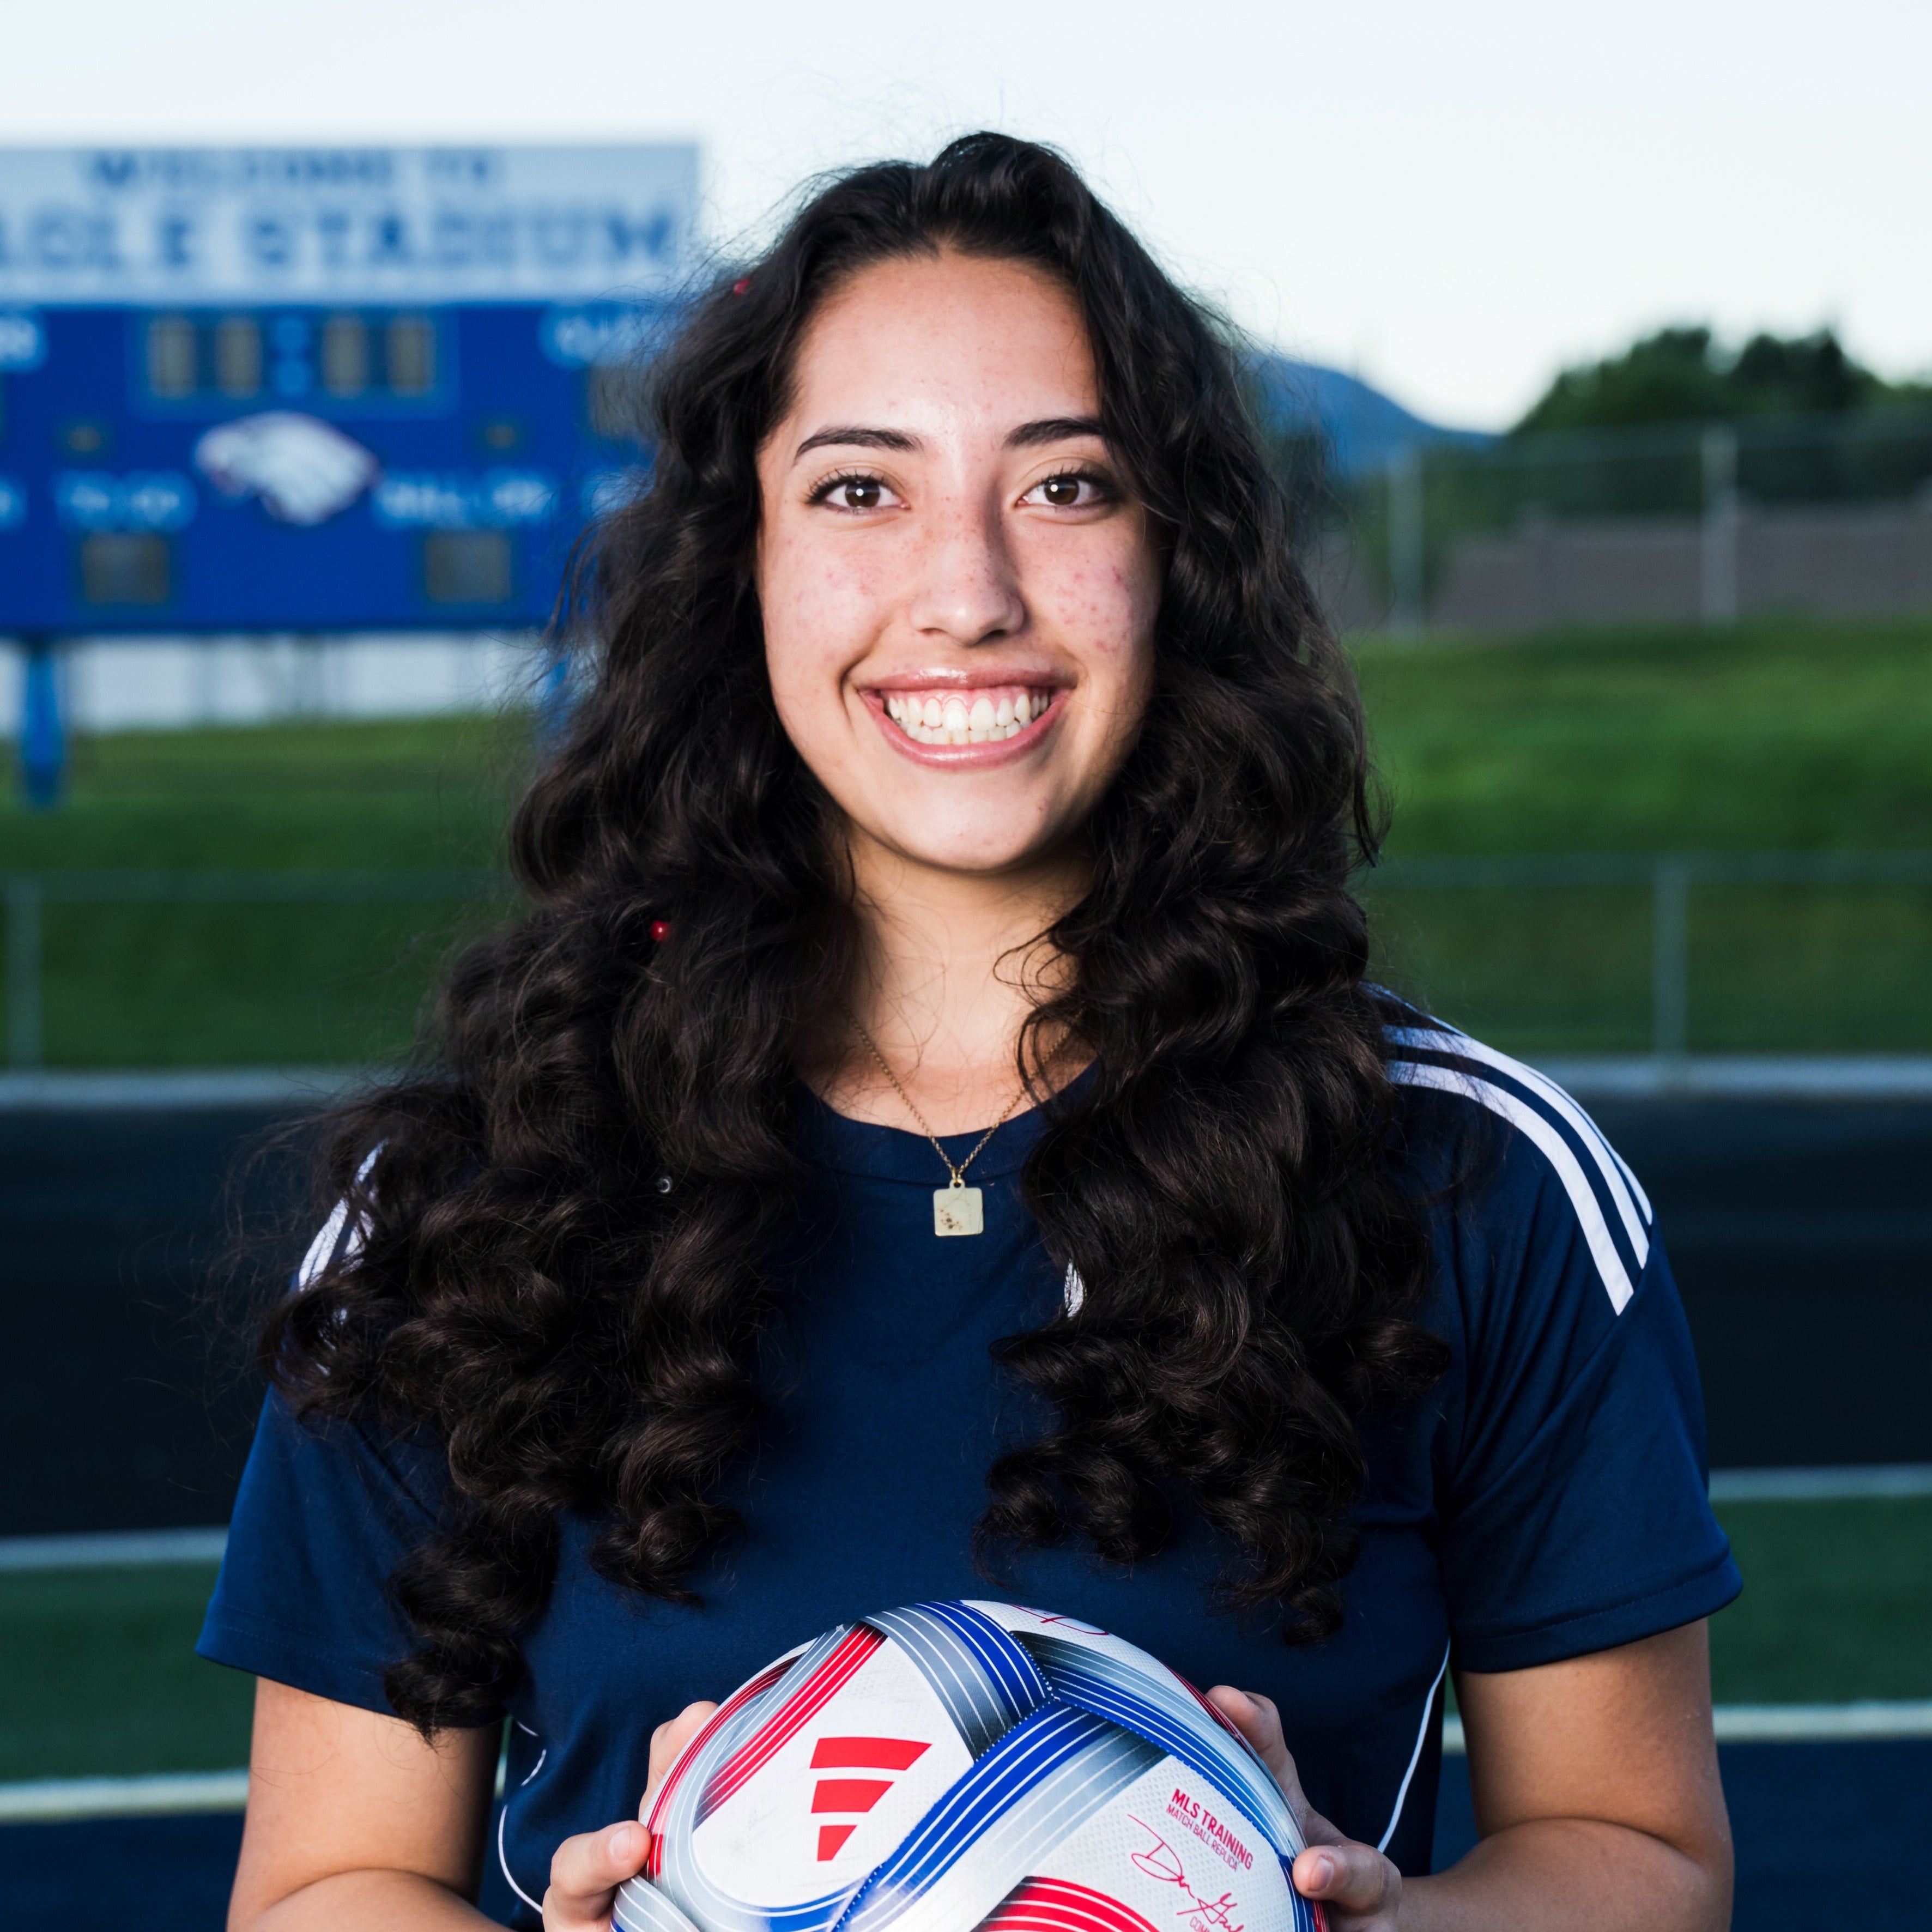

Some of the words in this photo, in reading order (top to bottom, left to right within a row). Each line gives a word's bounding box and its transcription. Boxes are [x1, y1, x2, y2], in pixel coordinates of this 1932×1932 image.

[240, 206, 674, 269] STADIUM
[1166, 1804, 1194, 1830] MATCH
[1193, 1824, 1210, 1845] BALL
[1212, 1839, 1237, 1872] REPLICA
[1172, 1788, 1200, 1818] MLS
[1202, 1809, 1253, 1870] TRAINING
